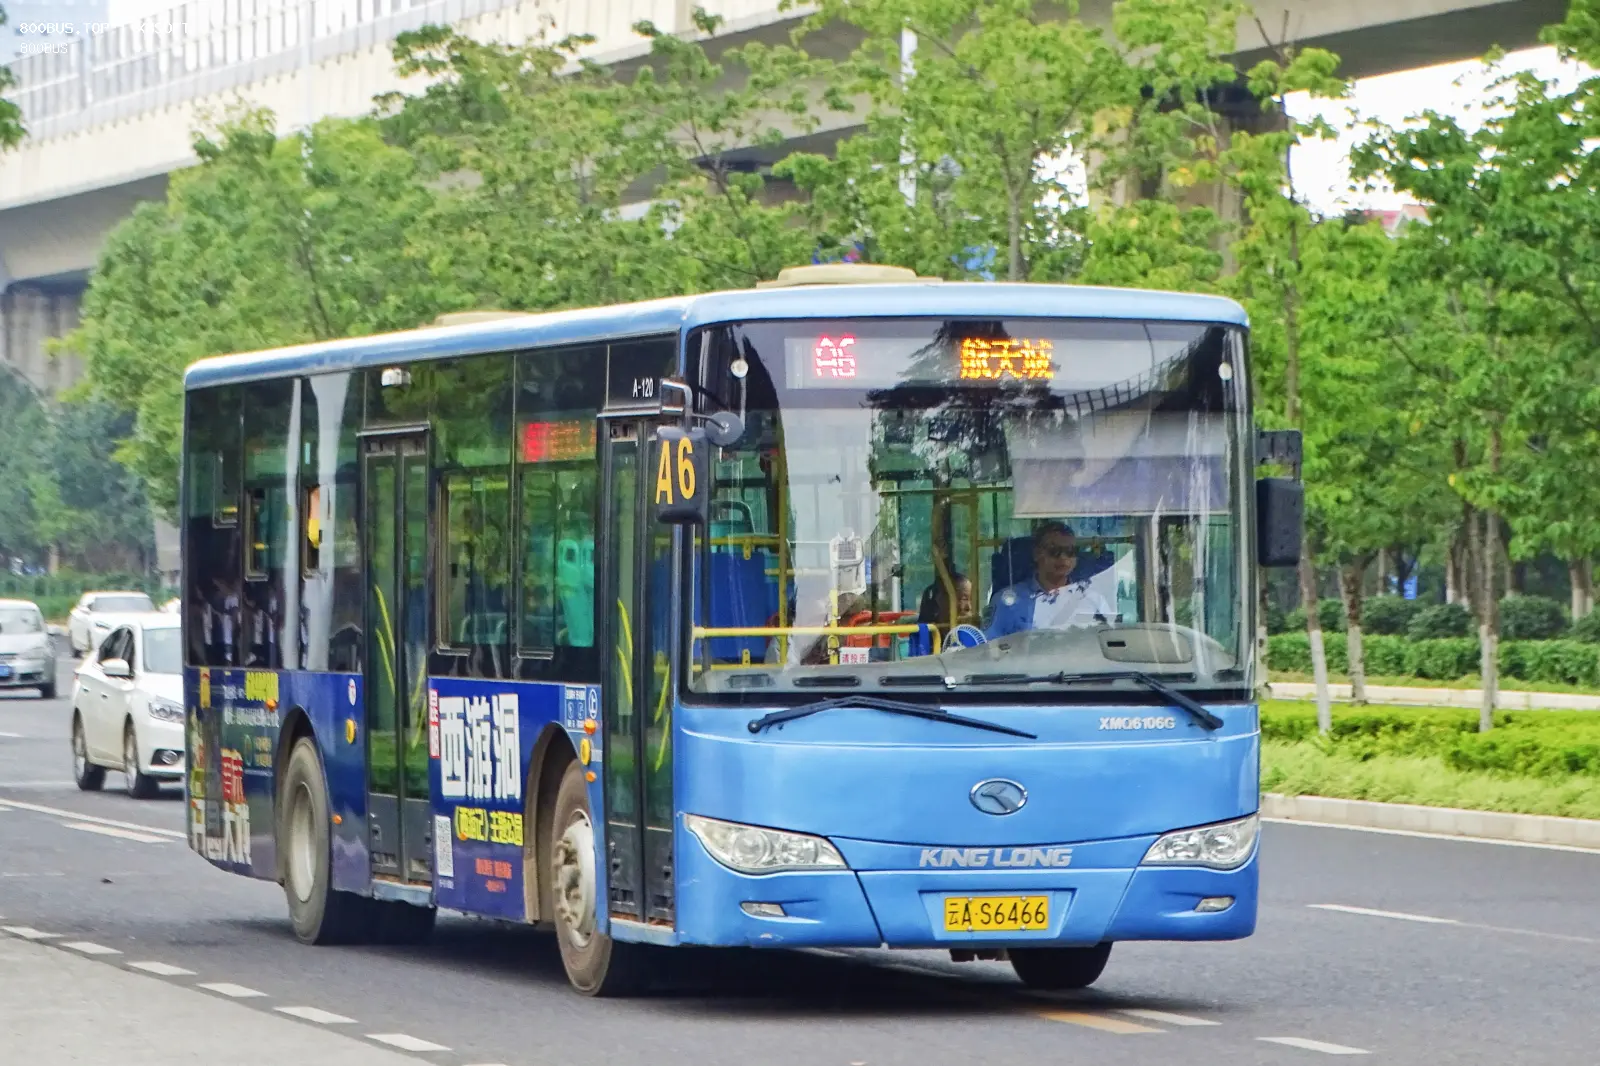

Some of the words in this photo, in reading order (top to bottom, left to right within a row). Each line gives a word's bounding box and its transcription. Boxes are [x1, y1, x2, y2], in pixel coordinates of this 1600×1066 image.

[632, 377, 654, 397] A-120
[655, 437, 696, 505] A6
[1099, 716, 1176, 730] XMQ6106G
[439, 693, 521, 799] 西游洞
[919, 848, 990, 868] KING
[992, 848, 1074, 868] LONG
